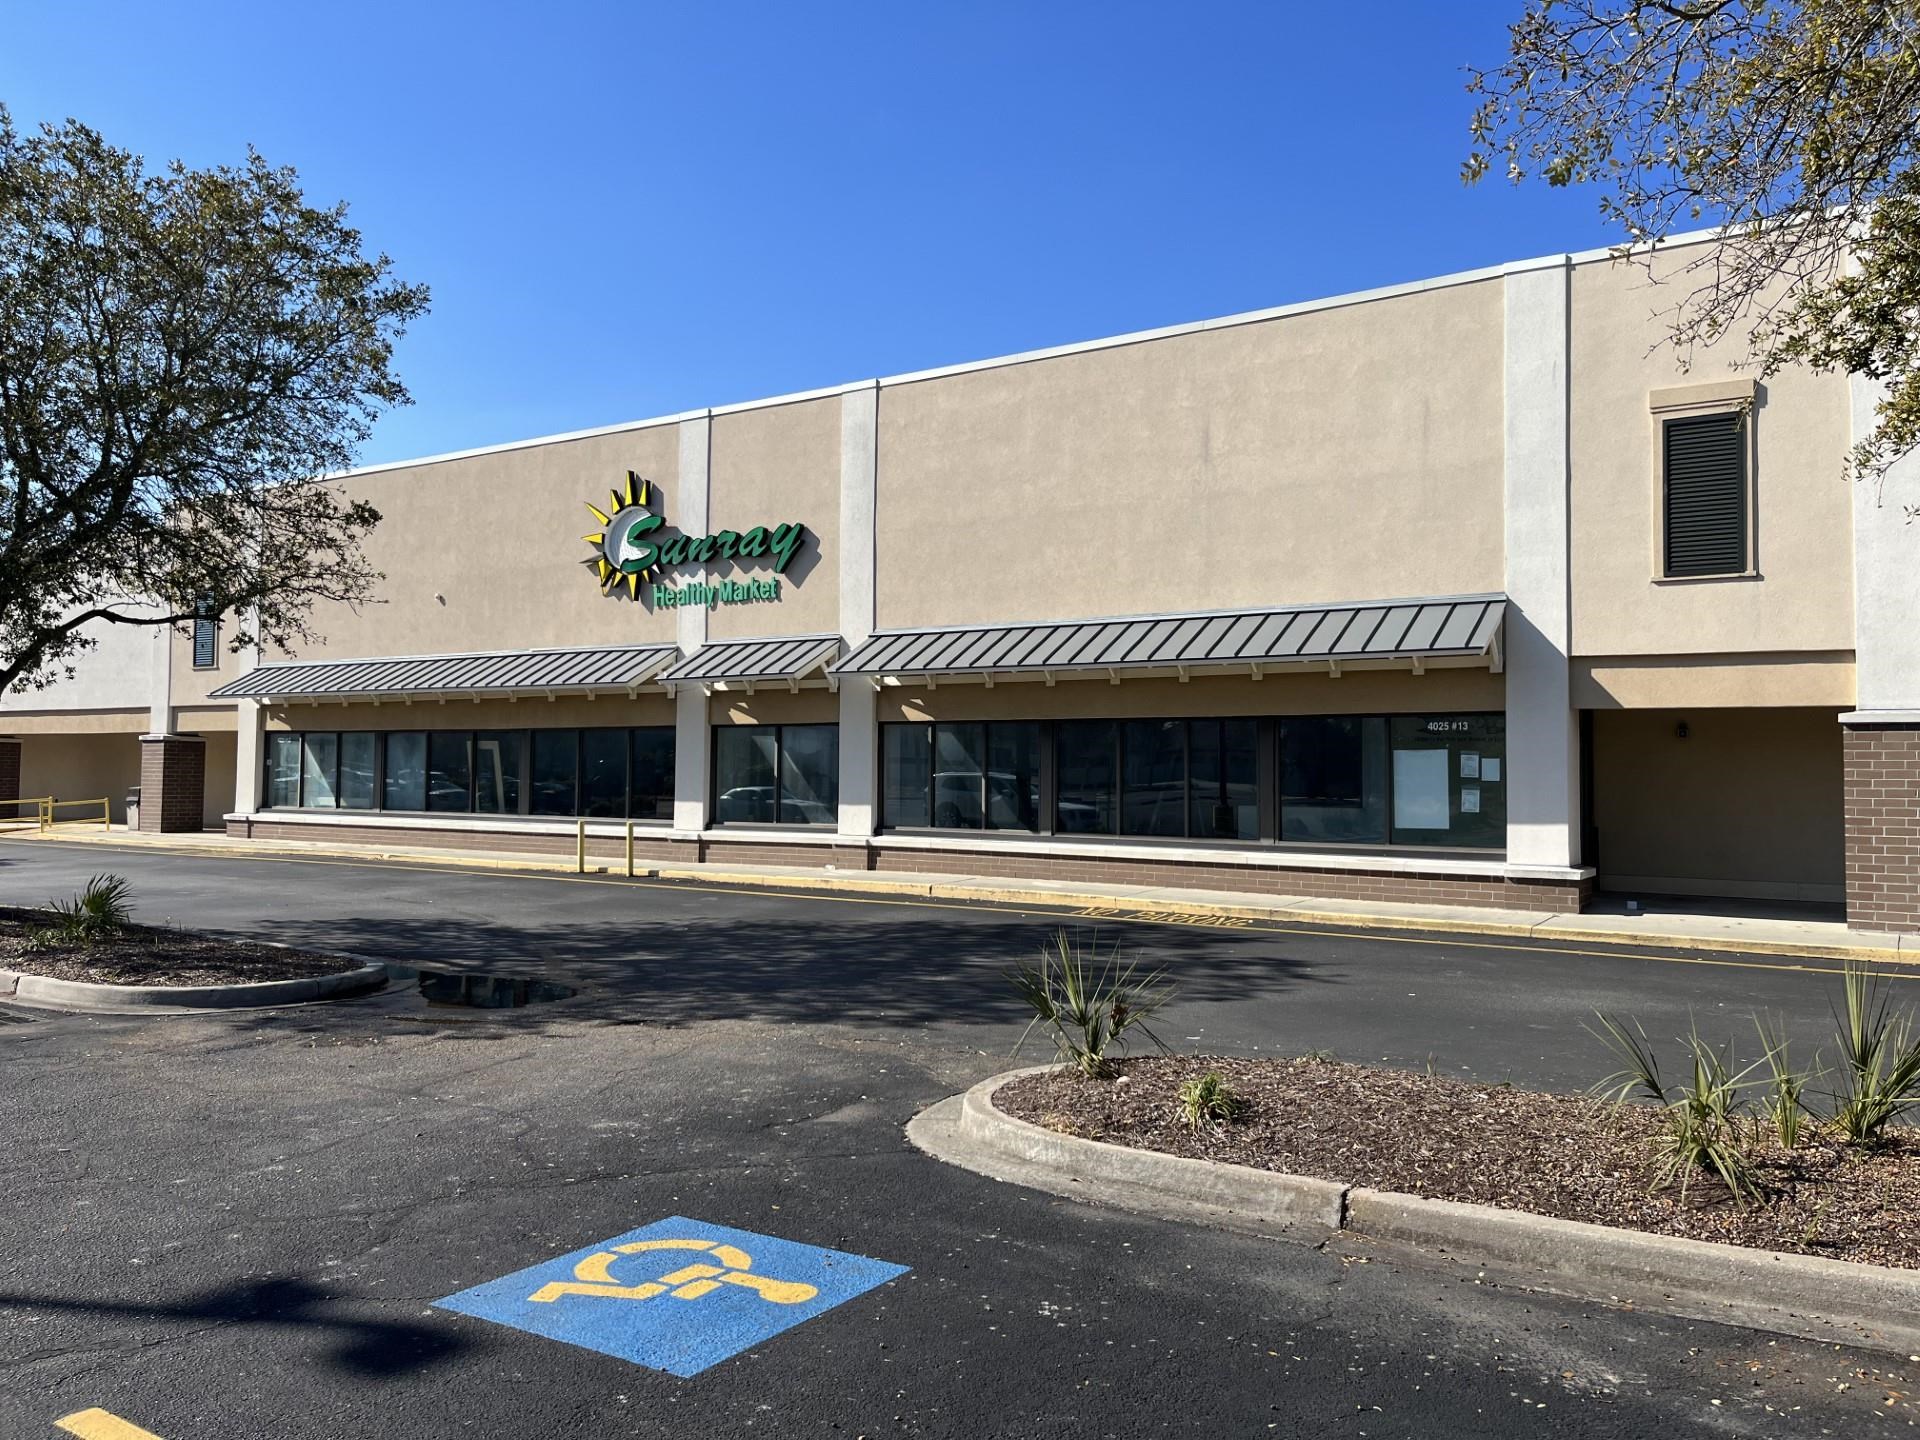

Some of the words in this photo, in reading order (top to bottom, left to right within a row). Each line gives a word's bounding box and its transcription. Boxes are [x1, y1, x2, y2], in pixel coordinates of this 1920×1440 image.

[619, 515, 804, 574] Sunray
[653, 581, 716, 608] Healthy
[719, 577, 778, 603] Market
[1427, 721, 1449, 731] 4025
[1452, 721, 1469, 731] #13
